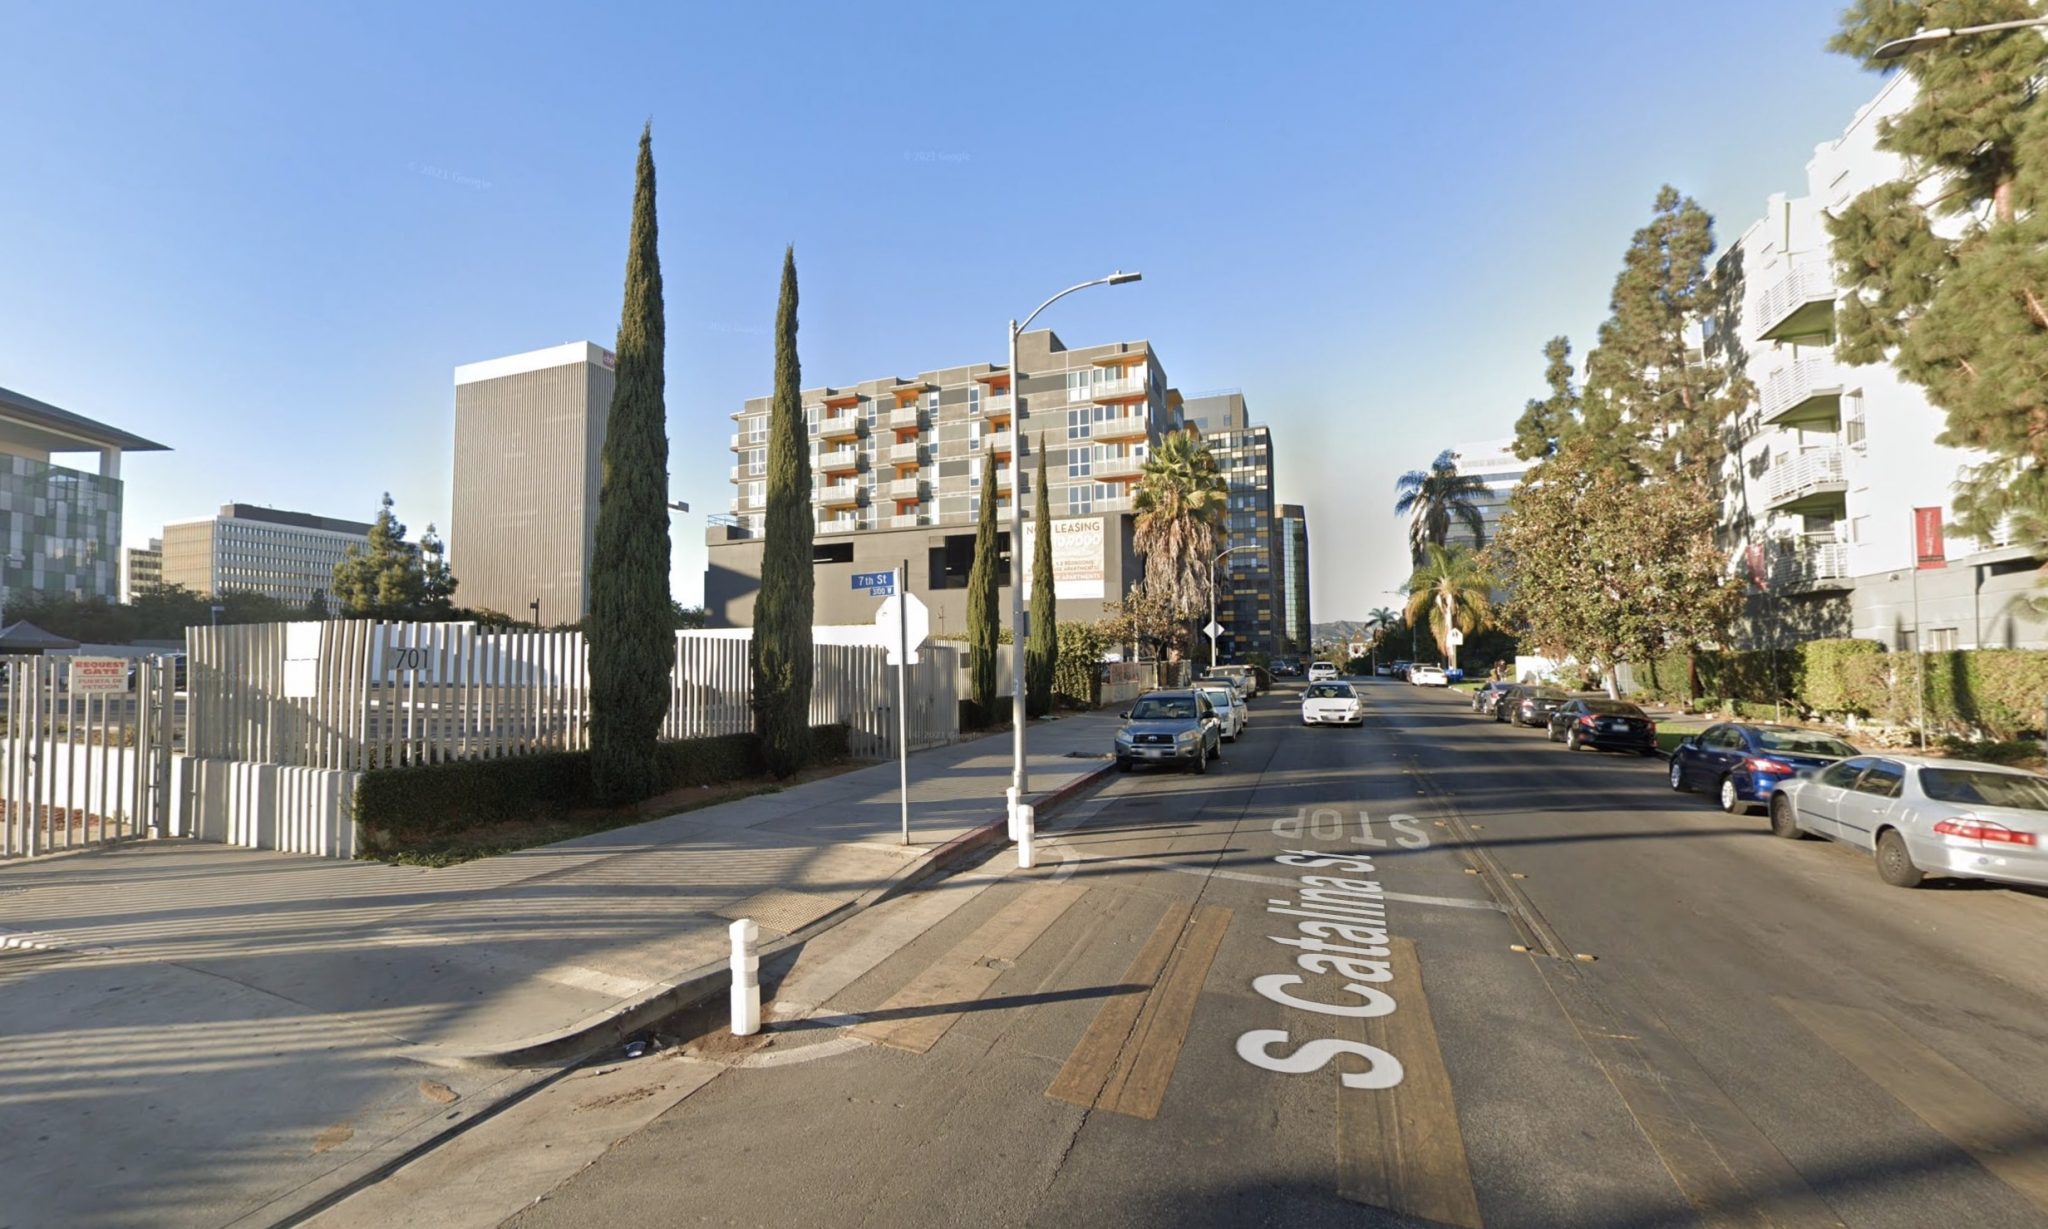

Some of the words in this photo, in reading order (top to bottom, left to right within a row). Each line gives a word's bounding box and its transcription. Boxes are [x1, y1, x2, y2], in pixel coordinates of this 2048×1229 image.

[1055, 521, 1100, 534] LEASING
[857, 576, 874, 586] 7th
[876, 574, 887, 585] St
[396, 648, 428, 669] 701
[1271, 808, 1431, 849] STOP
